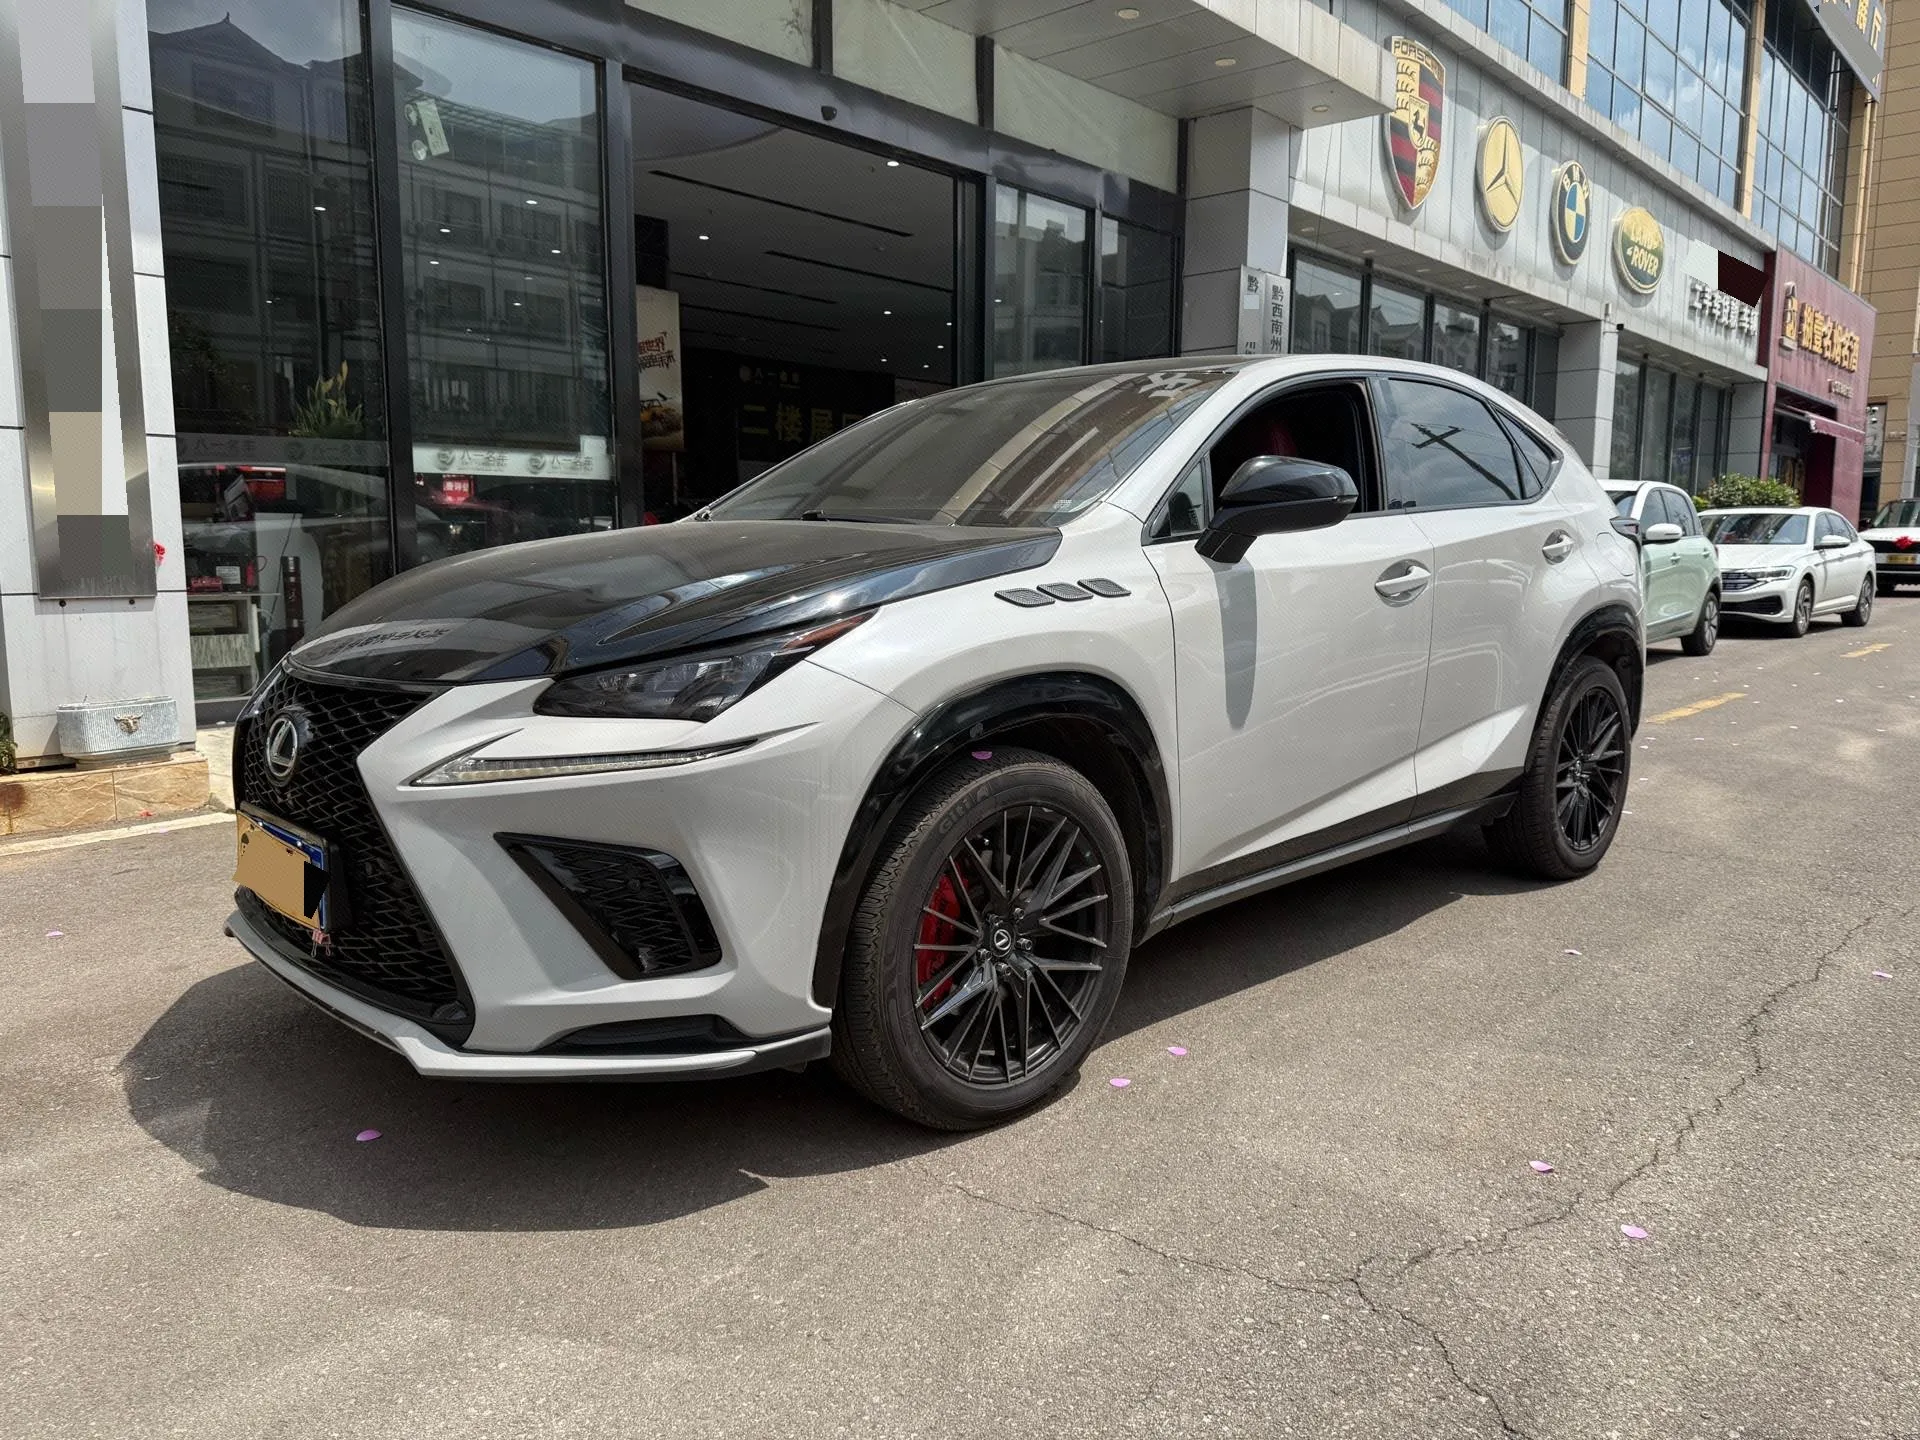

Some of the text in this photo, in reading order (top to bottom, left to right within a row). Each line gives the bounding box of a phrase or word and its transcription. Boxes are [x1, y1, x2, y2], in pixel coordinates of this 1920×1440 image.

[1562, 165, 1590, 199] BMW
[1630, 223, 1656, 249] LAND
[1631, 247, 1659, 277] ROVER
[741, 402, 868, 444] 二楼展
